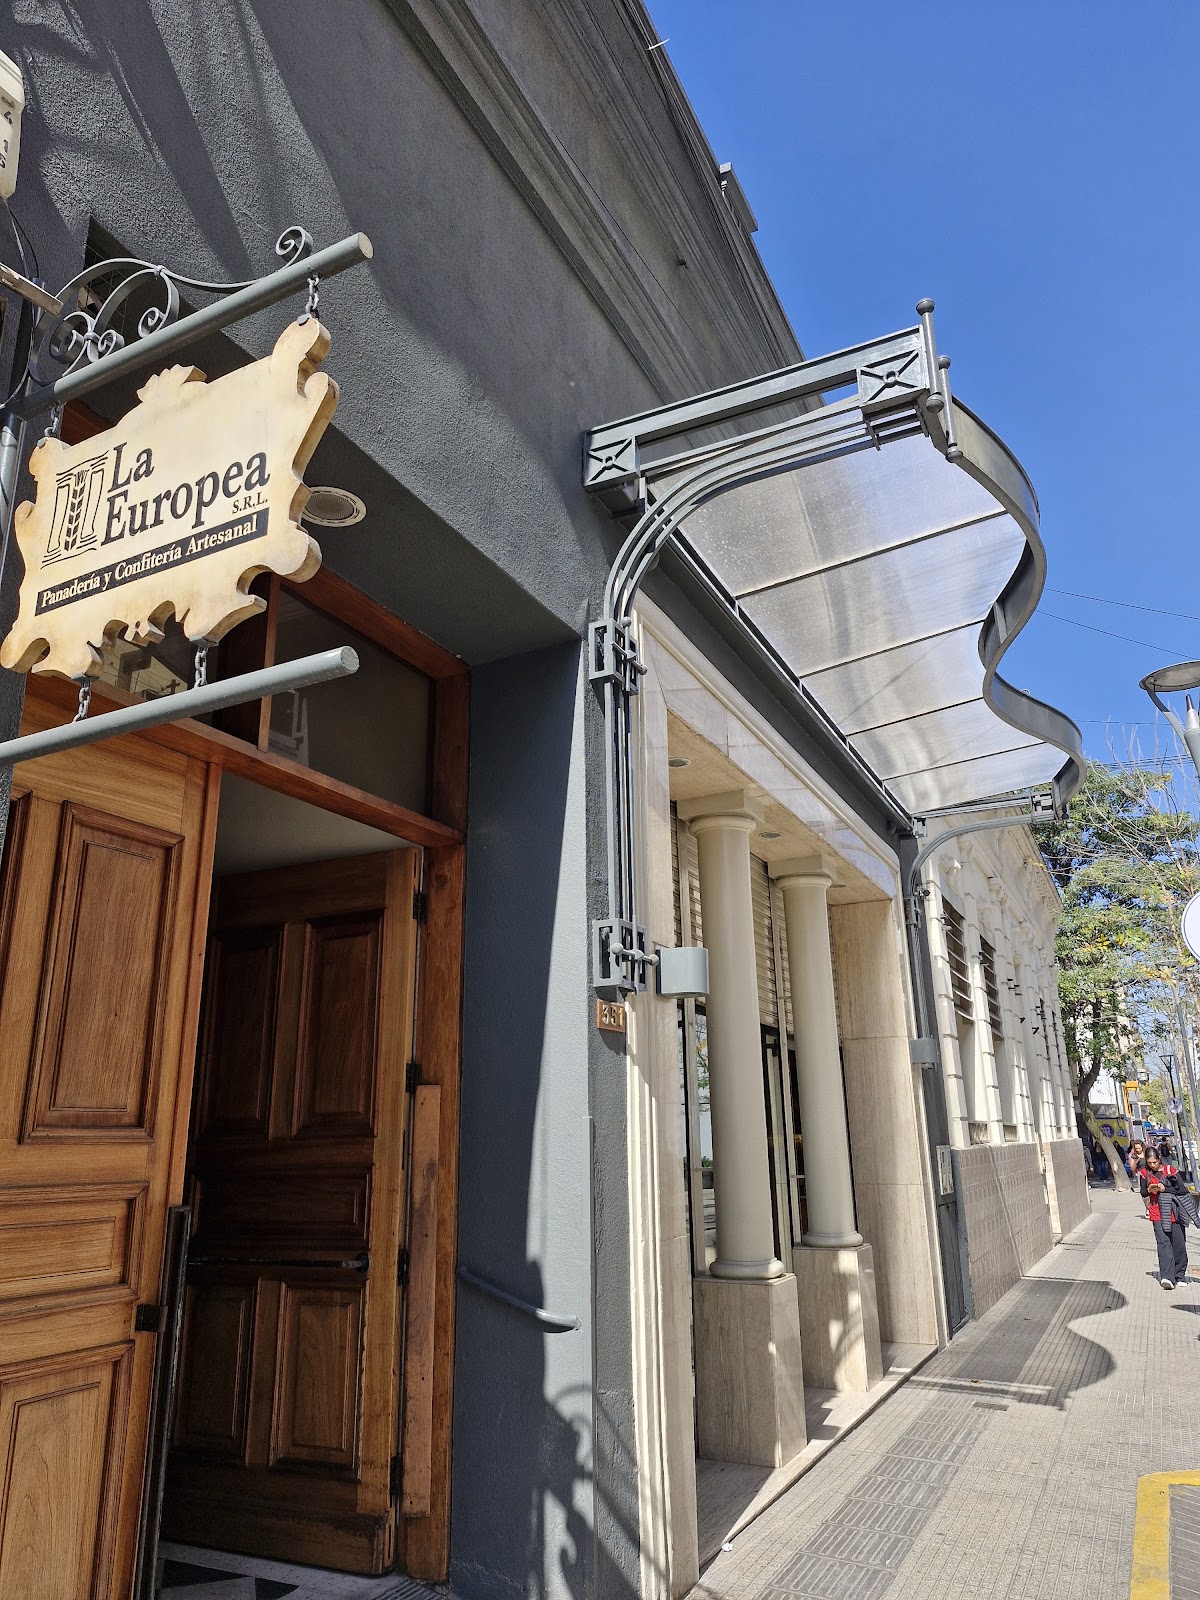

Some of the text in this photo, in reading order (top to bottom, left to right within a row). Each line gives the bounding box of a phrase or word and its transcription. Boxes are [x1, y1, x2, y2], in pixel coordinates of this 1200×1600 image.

[107, 441, 155, 493] La
[100, 451, 271, 547] Europea
[231, 491, 268, 514] S.R.L.
[40, 514, 258, 608] Panadería y Confitería Artesanal
[601, 1004, 624, 1027] 351
